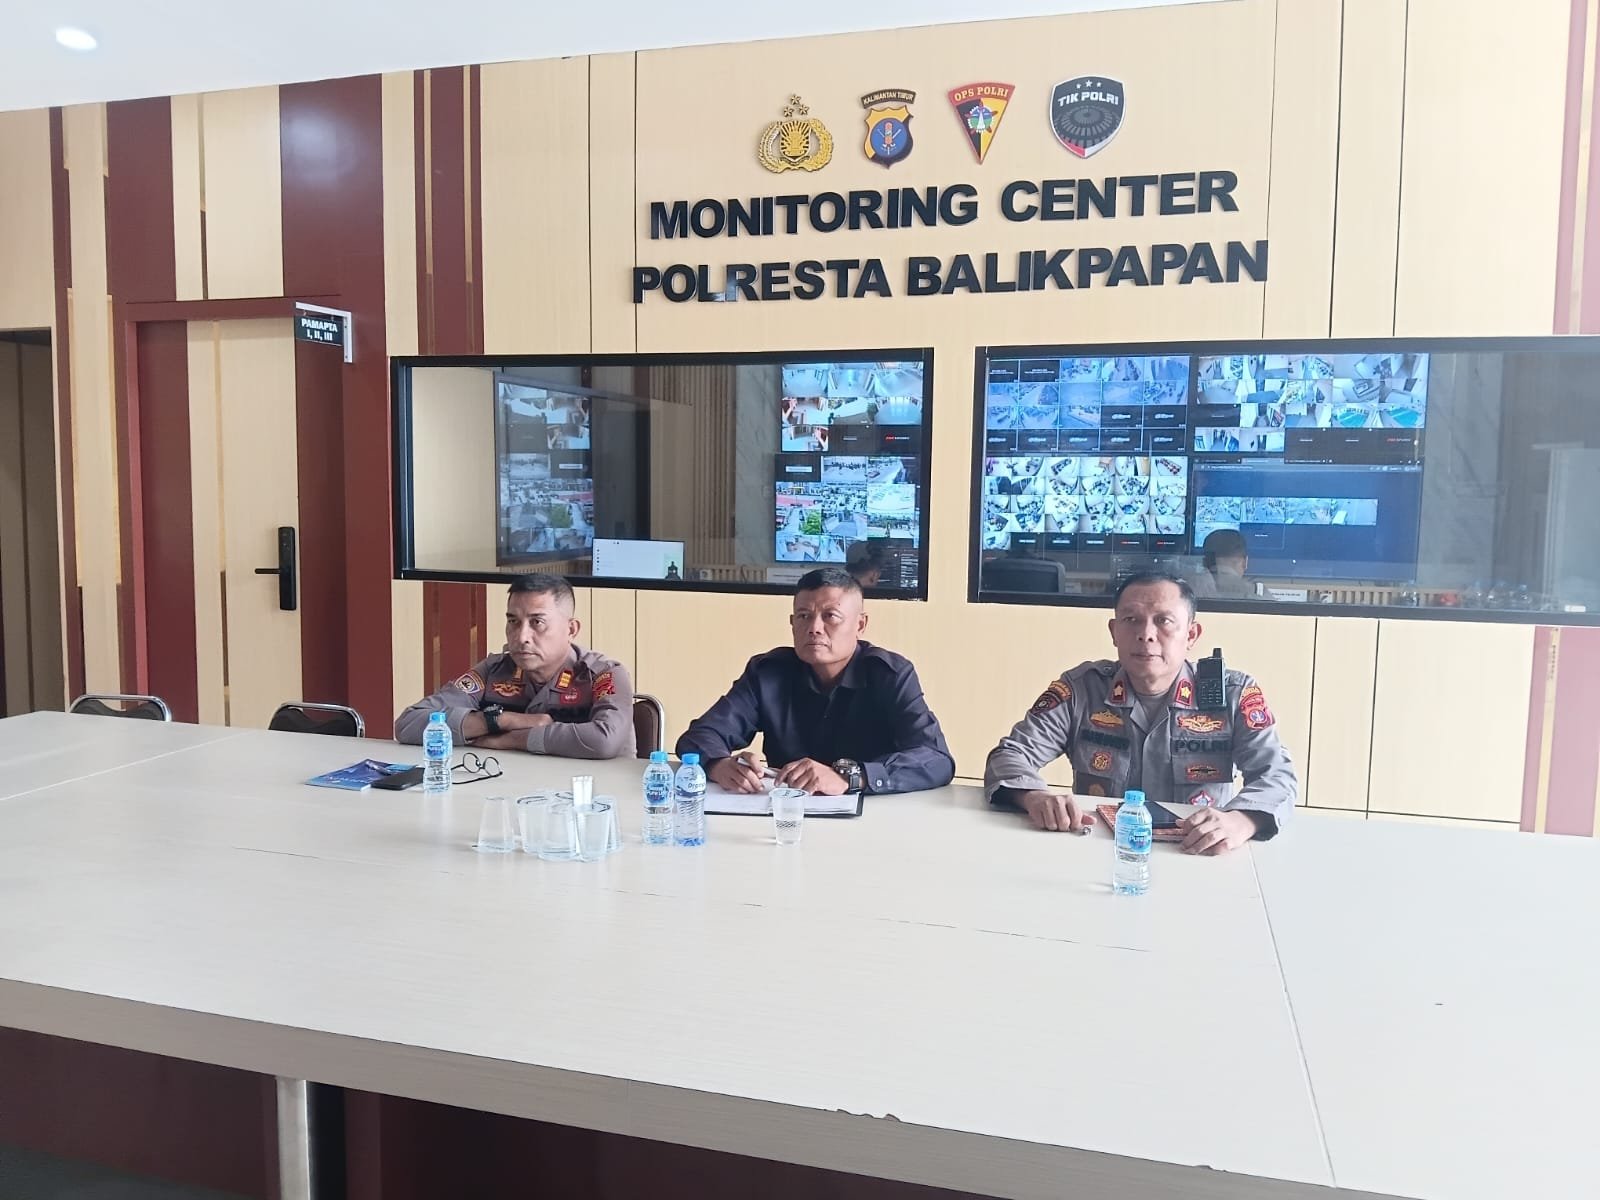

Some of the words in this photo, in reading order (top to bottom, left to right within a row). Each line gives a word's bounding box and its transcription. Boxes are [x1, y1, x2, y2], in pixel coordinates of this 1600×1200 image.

[954, 88, 974, 101] OPS
[977, 86, 1008, 98] POLRI
[1057, 93, 1079, 107] TIK
[1081, 91, 1119, 106] POLRI
[651, 184, 978, 240] MONITORING
[1001, 171, 1239, 222] CENTER
[633, 257, 892, 303] POLRESTA
[907, 240, 1269, 297] BALIKPAPAN
[301, 318, 338, 333] PAMAPTA
[324, 331, 333, 341] III
